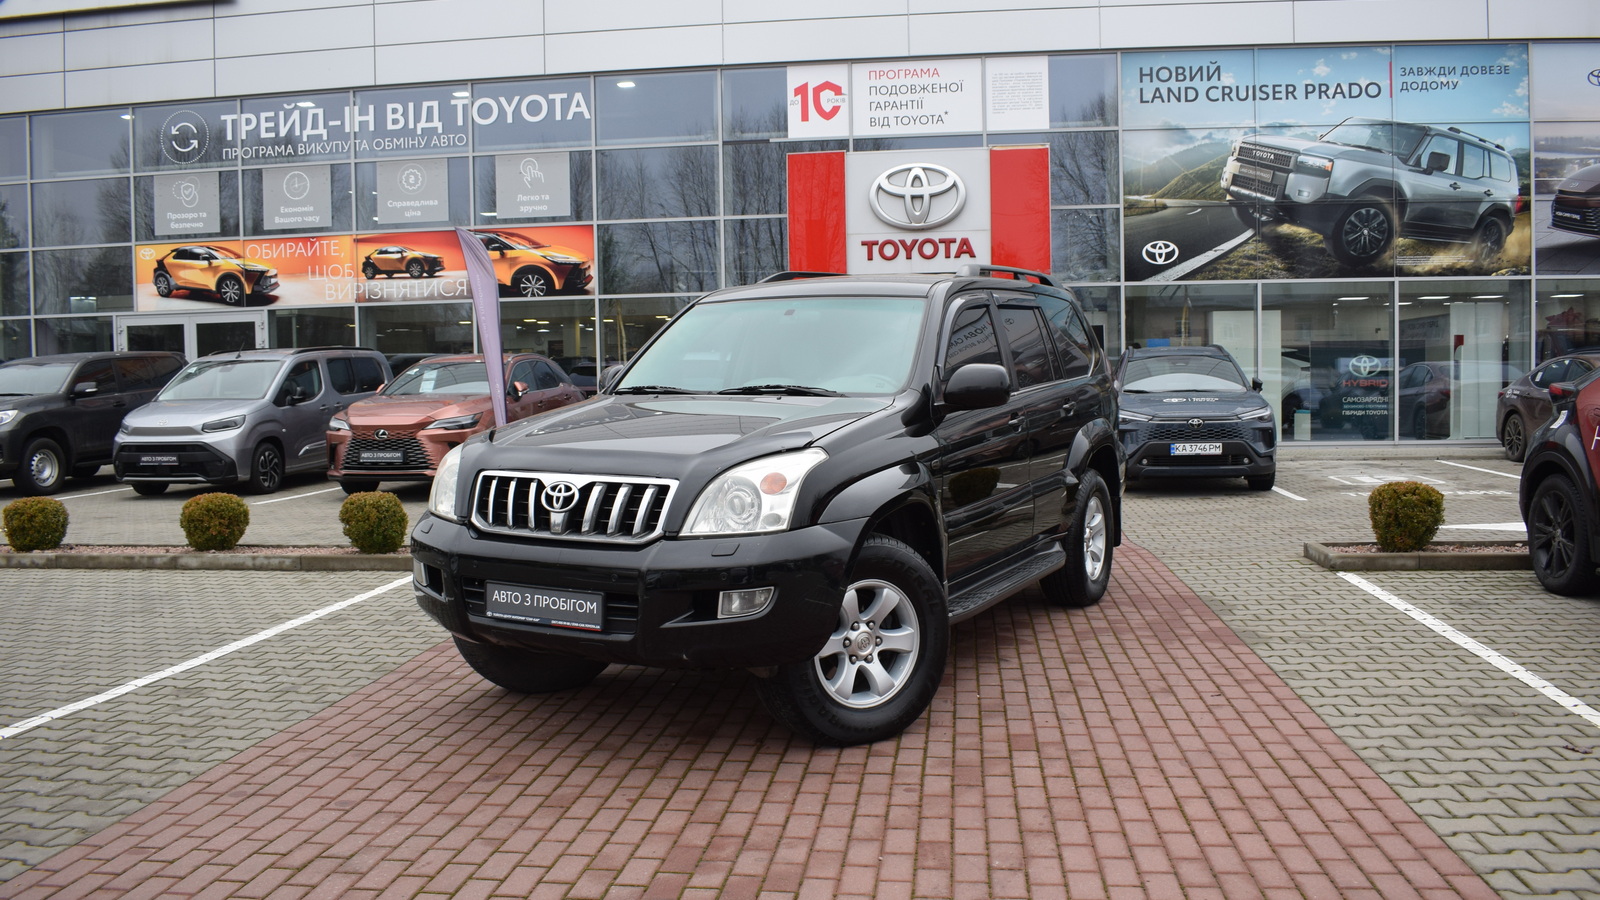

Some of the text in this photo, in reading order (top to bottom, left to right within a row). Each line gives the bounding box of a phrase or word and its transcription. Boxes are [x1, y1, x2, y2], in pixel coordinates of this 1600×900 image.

[868, 67, 940, 81] ПРОГРАМА
[1139, 61, 1222, 83] НОВИЙ
[1400, 65, 1510, 78] ЗАВЖДИ ДОВЕЗЕ
[869, 80, 964, 97] ПОДОВЖЕНОЇ
[1139, 81, 1383, 104] LAND CRUISER PRADO
[1400, 80, 1459, 93] ДОДОМУ
[869, 96, 925, 112] ГАРАНТІЇ
[220, 92, 591, 142] ТРЕЙД-ІН ВІД TOYOTA
[870, 116, 891, 129] ВІД
[222, 132, 468, 160] ПРОГРАМА ВИКУПУ ТА ОБМІНУ АВТО
[1252, 150, 1275, 160] TOYOTA
[387, 199, 439, 208] Справедлива
[516, 194, 540, 202] Легко
[167, 211, 198, 220] Прозоро
[280, 205, 314, 213] Економія
[404, 209, 422, 217] ціна
[519, 205, 548, 214] зручно
[170, 221, 204, 229] безпечно
[274, 215, 320, 224] Вашого часу
[246, 238, 345, 259] ОБИРАЙТЕ,
[861, 237, 977, 261] TOYOTA
[308, 263, 355, 282] ЩОБ
[325, 279, 468, 301] ВИРІЗНЯТИСЯ
[1342, 379, 1389, 388] HYBRID
[1188, 443, 1207, 452] 3746
[492, 590, 598, 614] АВТО З ПРОБІГОМ
